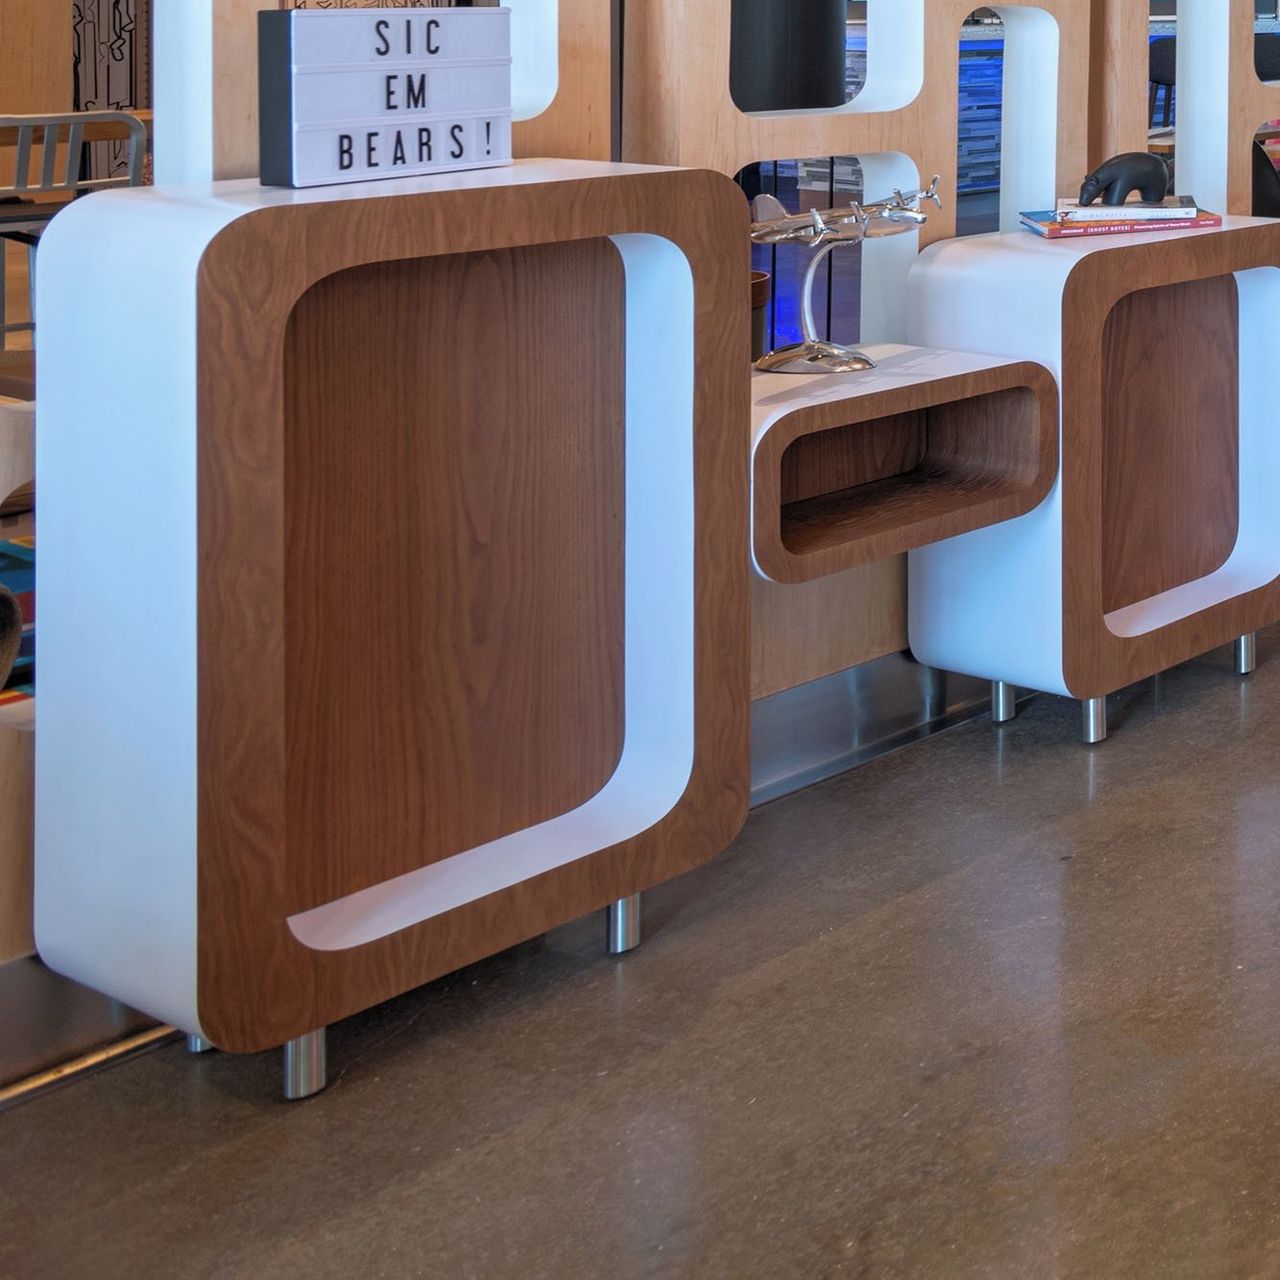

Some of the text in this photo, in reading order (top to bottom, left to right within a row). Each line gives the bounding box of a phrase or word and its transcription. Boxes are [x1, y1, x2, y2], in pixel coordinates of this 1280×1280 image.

[375, 19, 441, 56] SIC
[385, 73, 427, 110] EM
[338, 121, 492, 170] BEARS!
